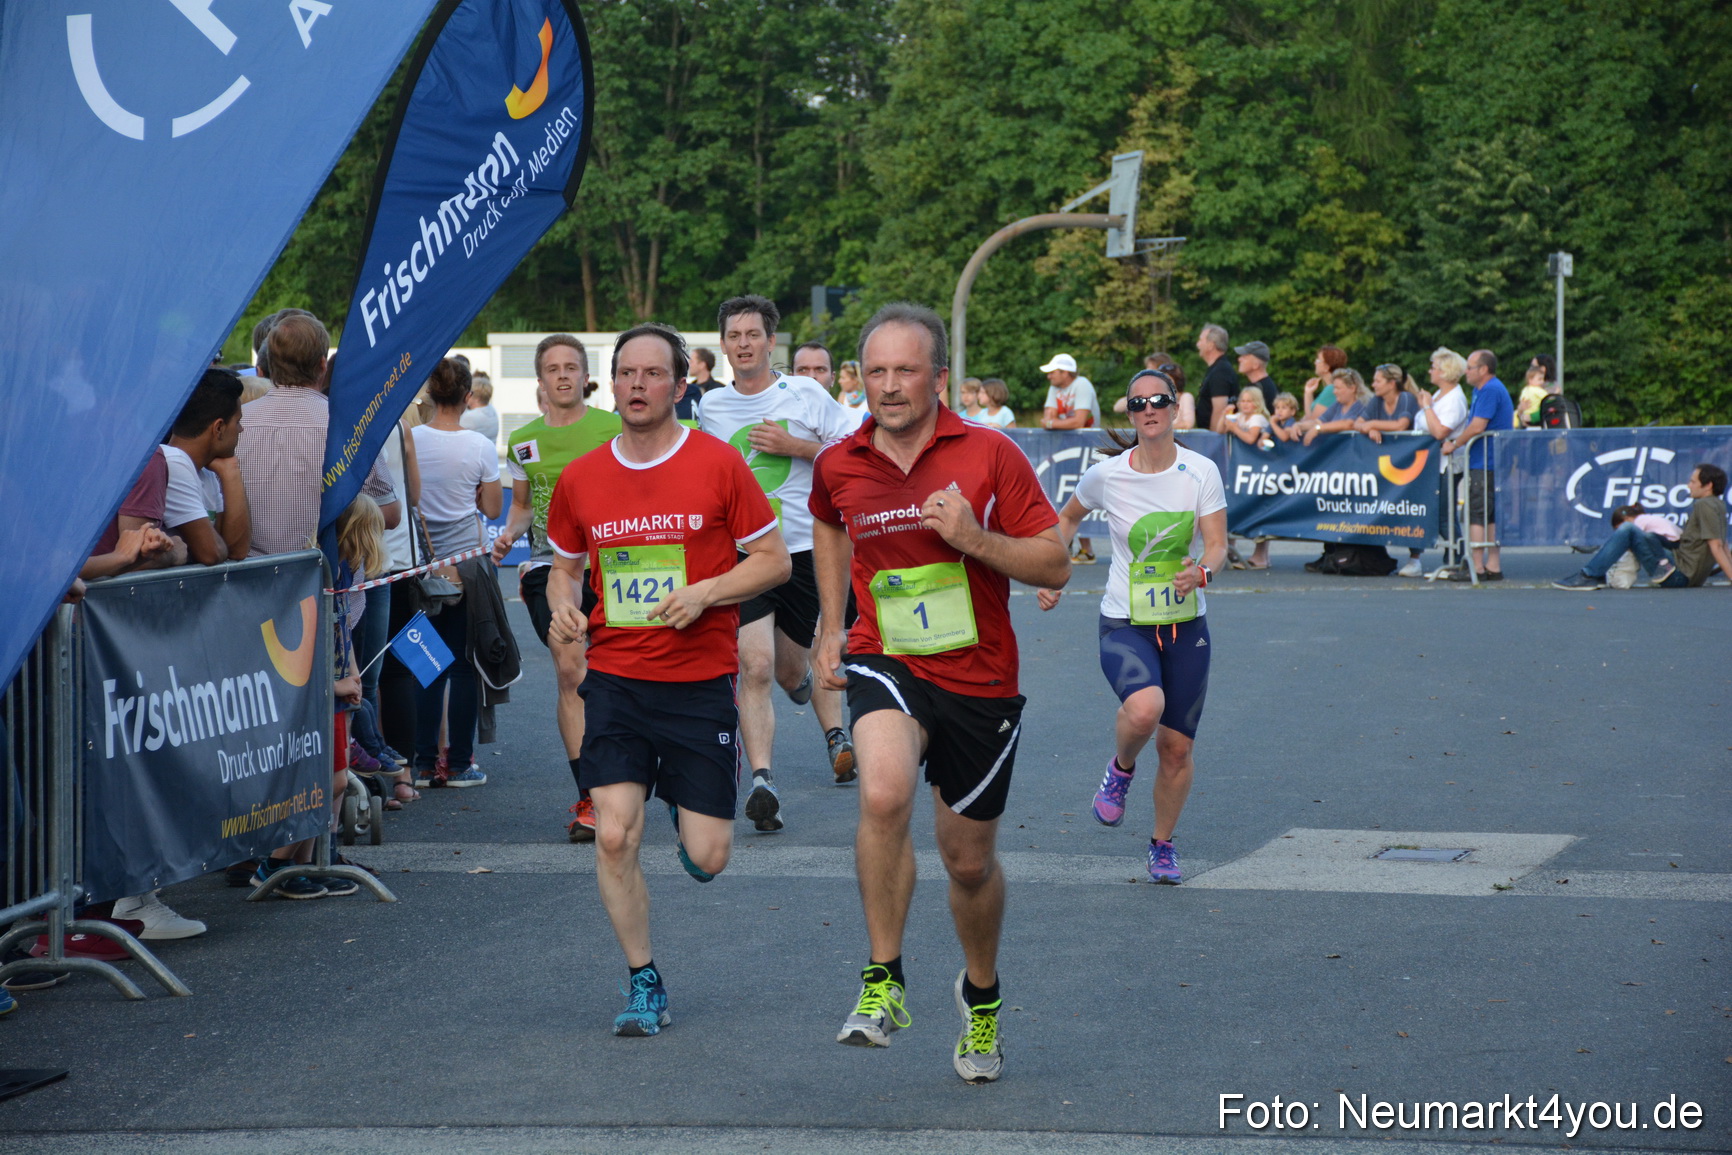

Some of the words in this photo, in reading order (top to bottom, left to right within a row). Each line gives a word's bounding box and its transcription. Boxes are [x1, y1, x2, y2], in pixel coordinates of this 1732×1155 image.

[462, 199, 503, 259] Druck
[527, 106, 578, 182] Medien
[360, 131, 520, 348] Frischmann
[1234, 464, 1378, 497] Frischmann
[1316, 496, 1352, 514] Druck
[1354, 499, 1377, 515] und
[1376, 500, 1427, 517] Medien
[591, 514, 685, 541] NEUMARKT
[645, 534, 667, 542] STARKE
[1316, 521, 1425, 539] www.frischmann-net.de
[611, 576, 675, 604] 1421
[913, 601, 929, 630] 1
[933, 629, 966, 640] Stromberg
[103, 665, 279, 760] Frischmann
[217, 740, 256, 784] Druck
[257, 732, 284, 774] und
